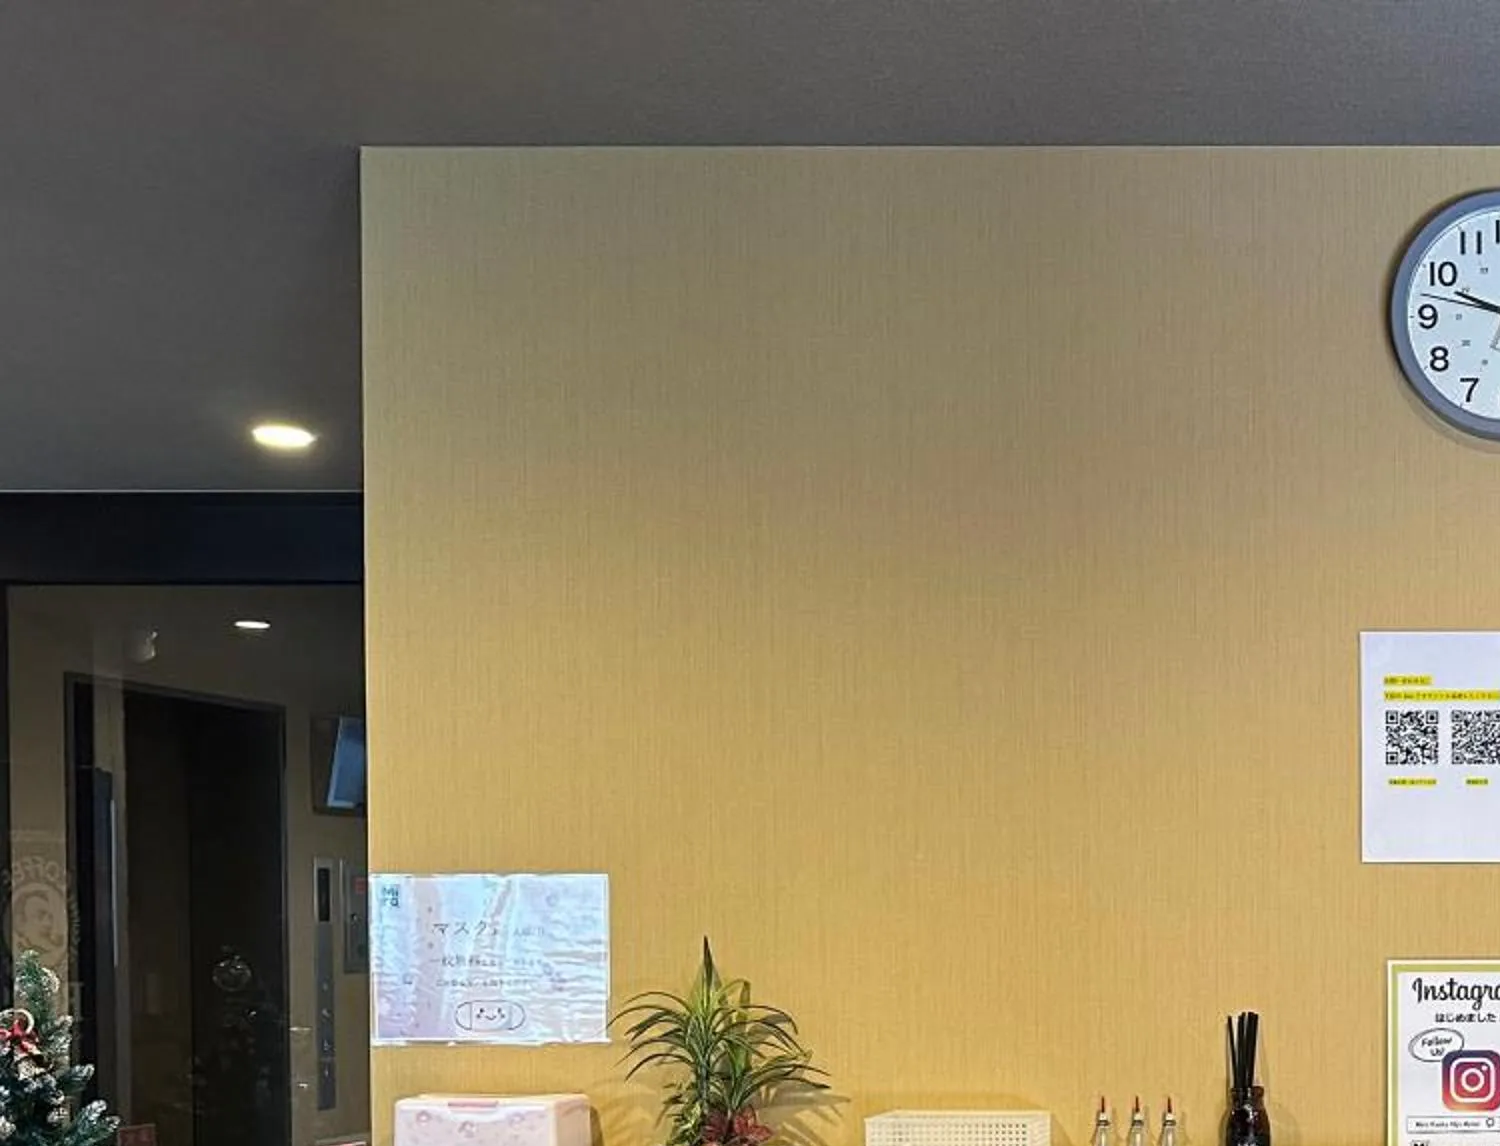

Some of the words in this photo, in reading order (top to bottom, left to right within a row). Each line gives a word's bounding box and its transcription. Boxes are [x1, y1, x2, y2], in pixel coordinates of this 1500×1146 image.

[1460, 231, 1482, 254] 11
[1429, 261, 1458, 286] 10
[1417, 304, 1439, 329] 9
[1429, 346, 1449, 372] 8
[1460, 378, 1480, 402] 7
